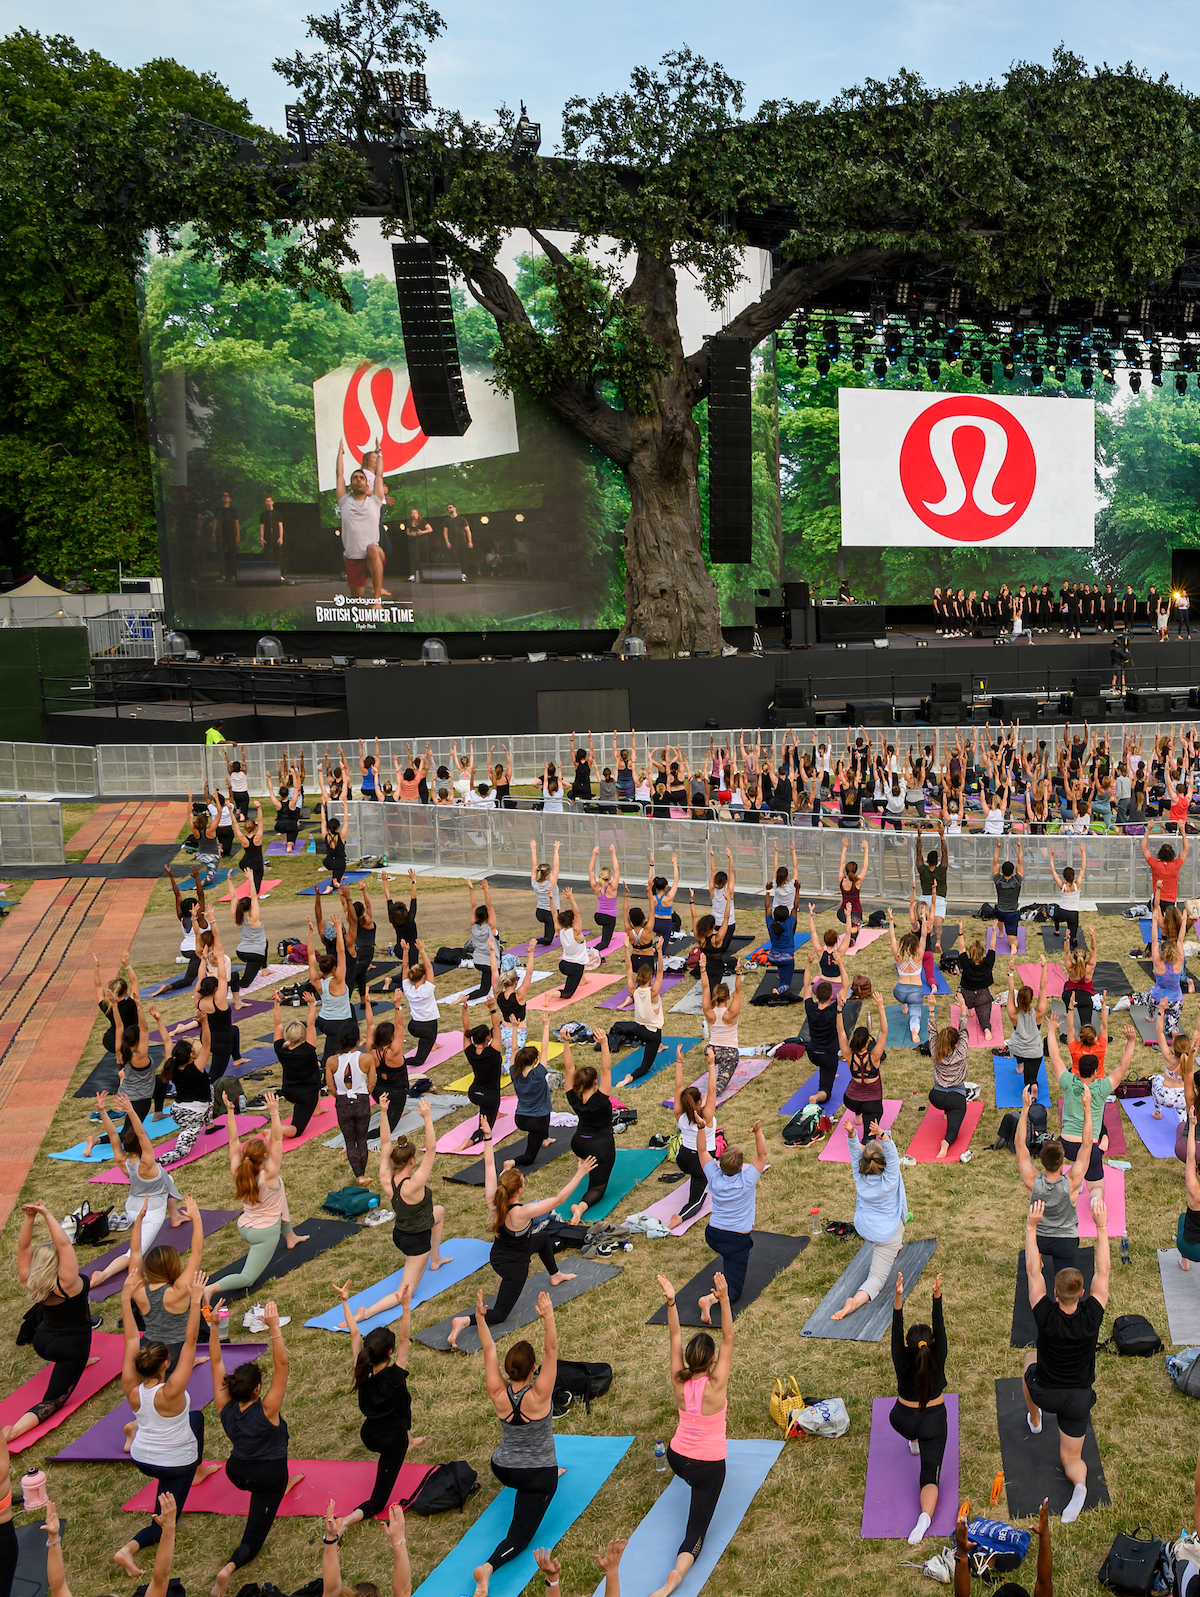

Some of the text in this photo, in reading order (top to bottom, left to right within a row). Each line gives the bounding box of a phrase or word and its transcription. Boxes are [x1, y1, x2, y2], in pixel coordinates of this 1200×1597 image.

[346, 597, 382, 605] barclaycard
[316, 606, 414, 623] BRITISH SUMMER TIME
